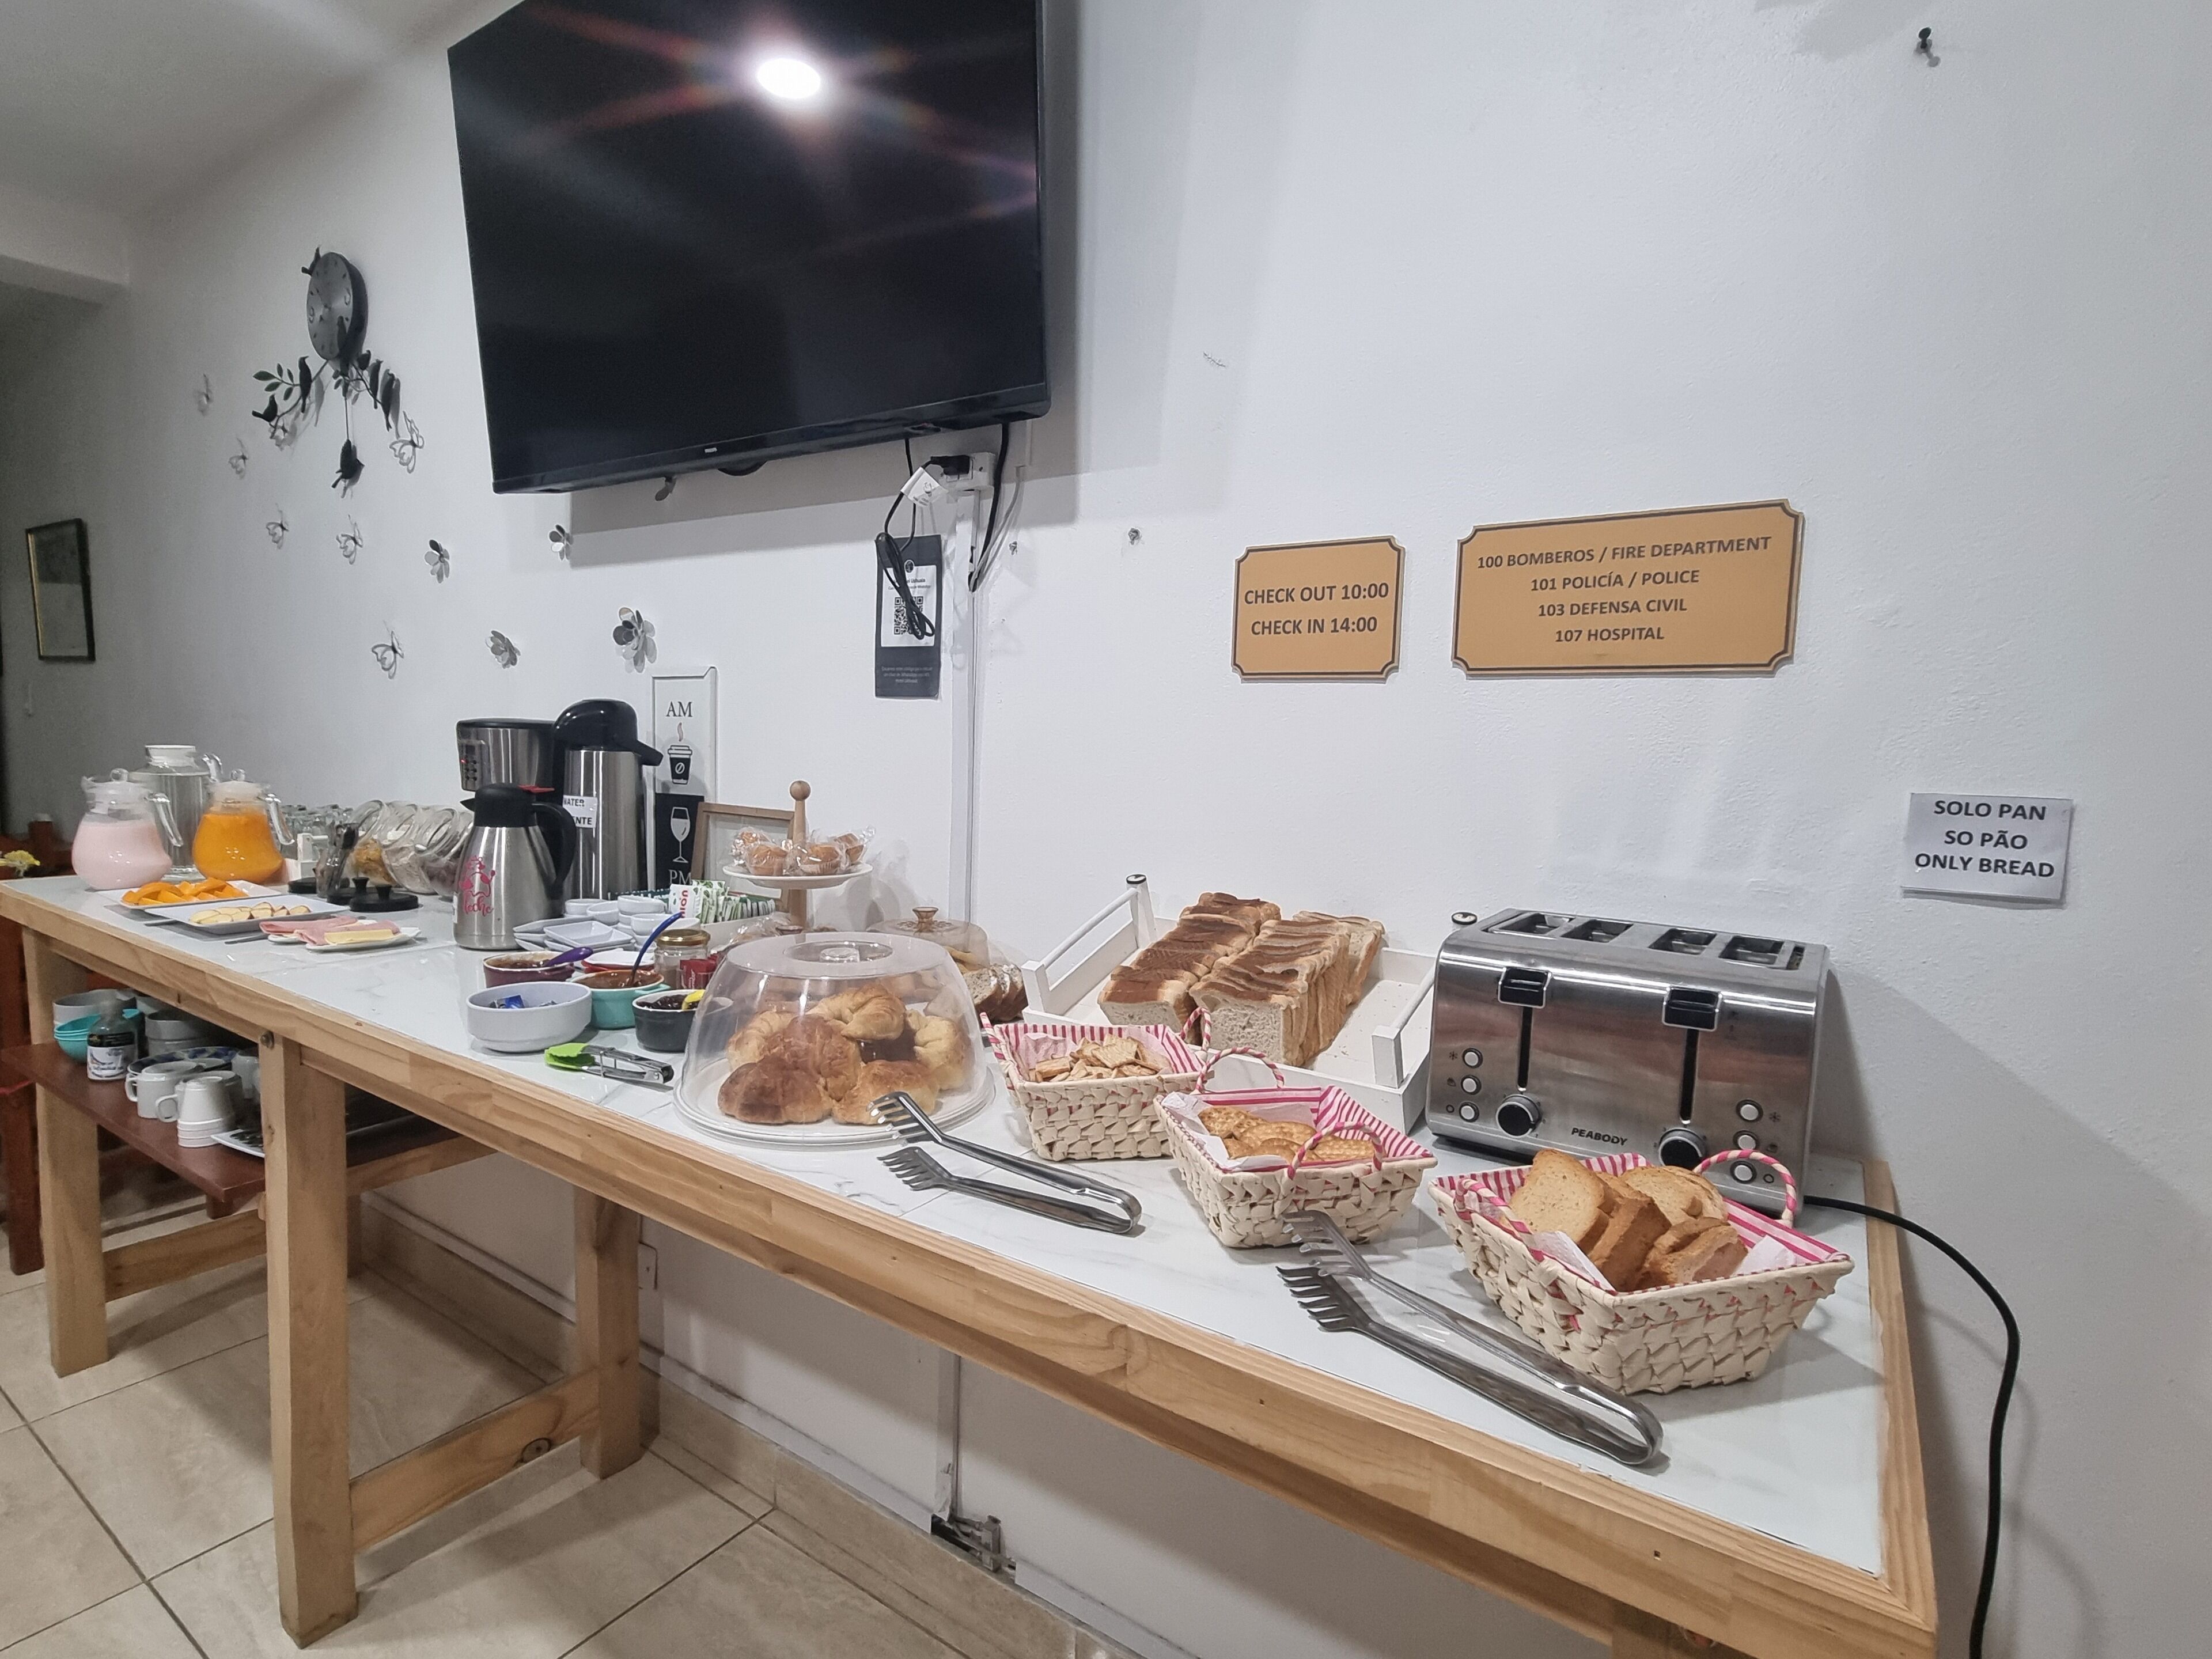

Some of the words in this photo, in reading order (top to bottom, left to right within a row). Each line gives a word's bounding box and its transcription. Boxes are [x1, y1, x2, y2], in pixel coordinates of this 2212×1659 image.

[1478, 555, 1503, 569] 100
[1507, 548, 1594, 566] BOMBEROS
[1599, 546, 1607, 563] /
[1611, 546, 1646, 560] FIRE
[1650, 536, 1772, 558] DEPARTMENT
[1531, 578, 1557, 591] 101
[1562, 571, 1623, 589] POLICÍA
[1628, 571, 1637, 588] /
[1642, 570, 1700, 585] POLICE
[1244, 588, 1296, 604] CHECK
[1300, 585, 1336, 601] OUT
[1341, 582, 1389, 600] 10:00
[1539, 604, 1565, 616] 103
[1570, 600, 1641, 616] DEFENSA
[1646, 599, 1687, 612] CIVIL
[1251, 619, 1302, 635] CHECK
[1307, 619, 1324, 634] IN
[1331, 616, 1377, 632] 14:00
[1555, 630, 1582, 642] 107
[1587, 627, 1665, 642] HOSPITAL
[666, 701, 692, 717] AM
[1933, 800, 1992, 817] SOLO
[1998, 804, 2046, 820] PAN
[572, 816, 593, 825] NTE
[1944, 830, 1974, 846] SO
[1980, 830, 2028, 849] PÃO
[1915, 853, 1973, 870] ONLY
[1979, 858, 2055, 877] BREAD
[668, 869, 692, 885] PM
[1571, 1127, 1628, 1146] PEABODY
